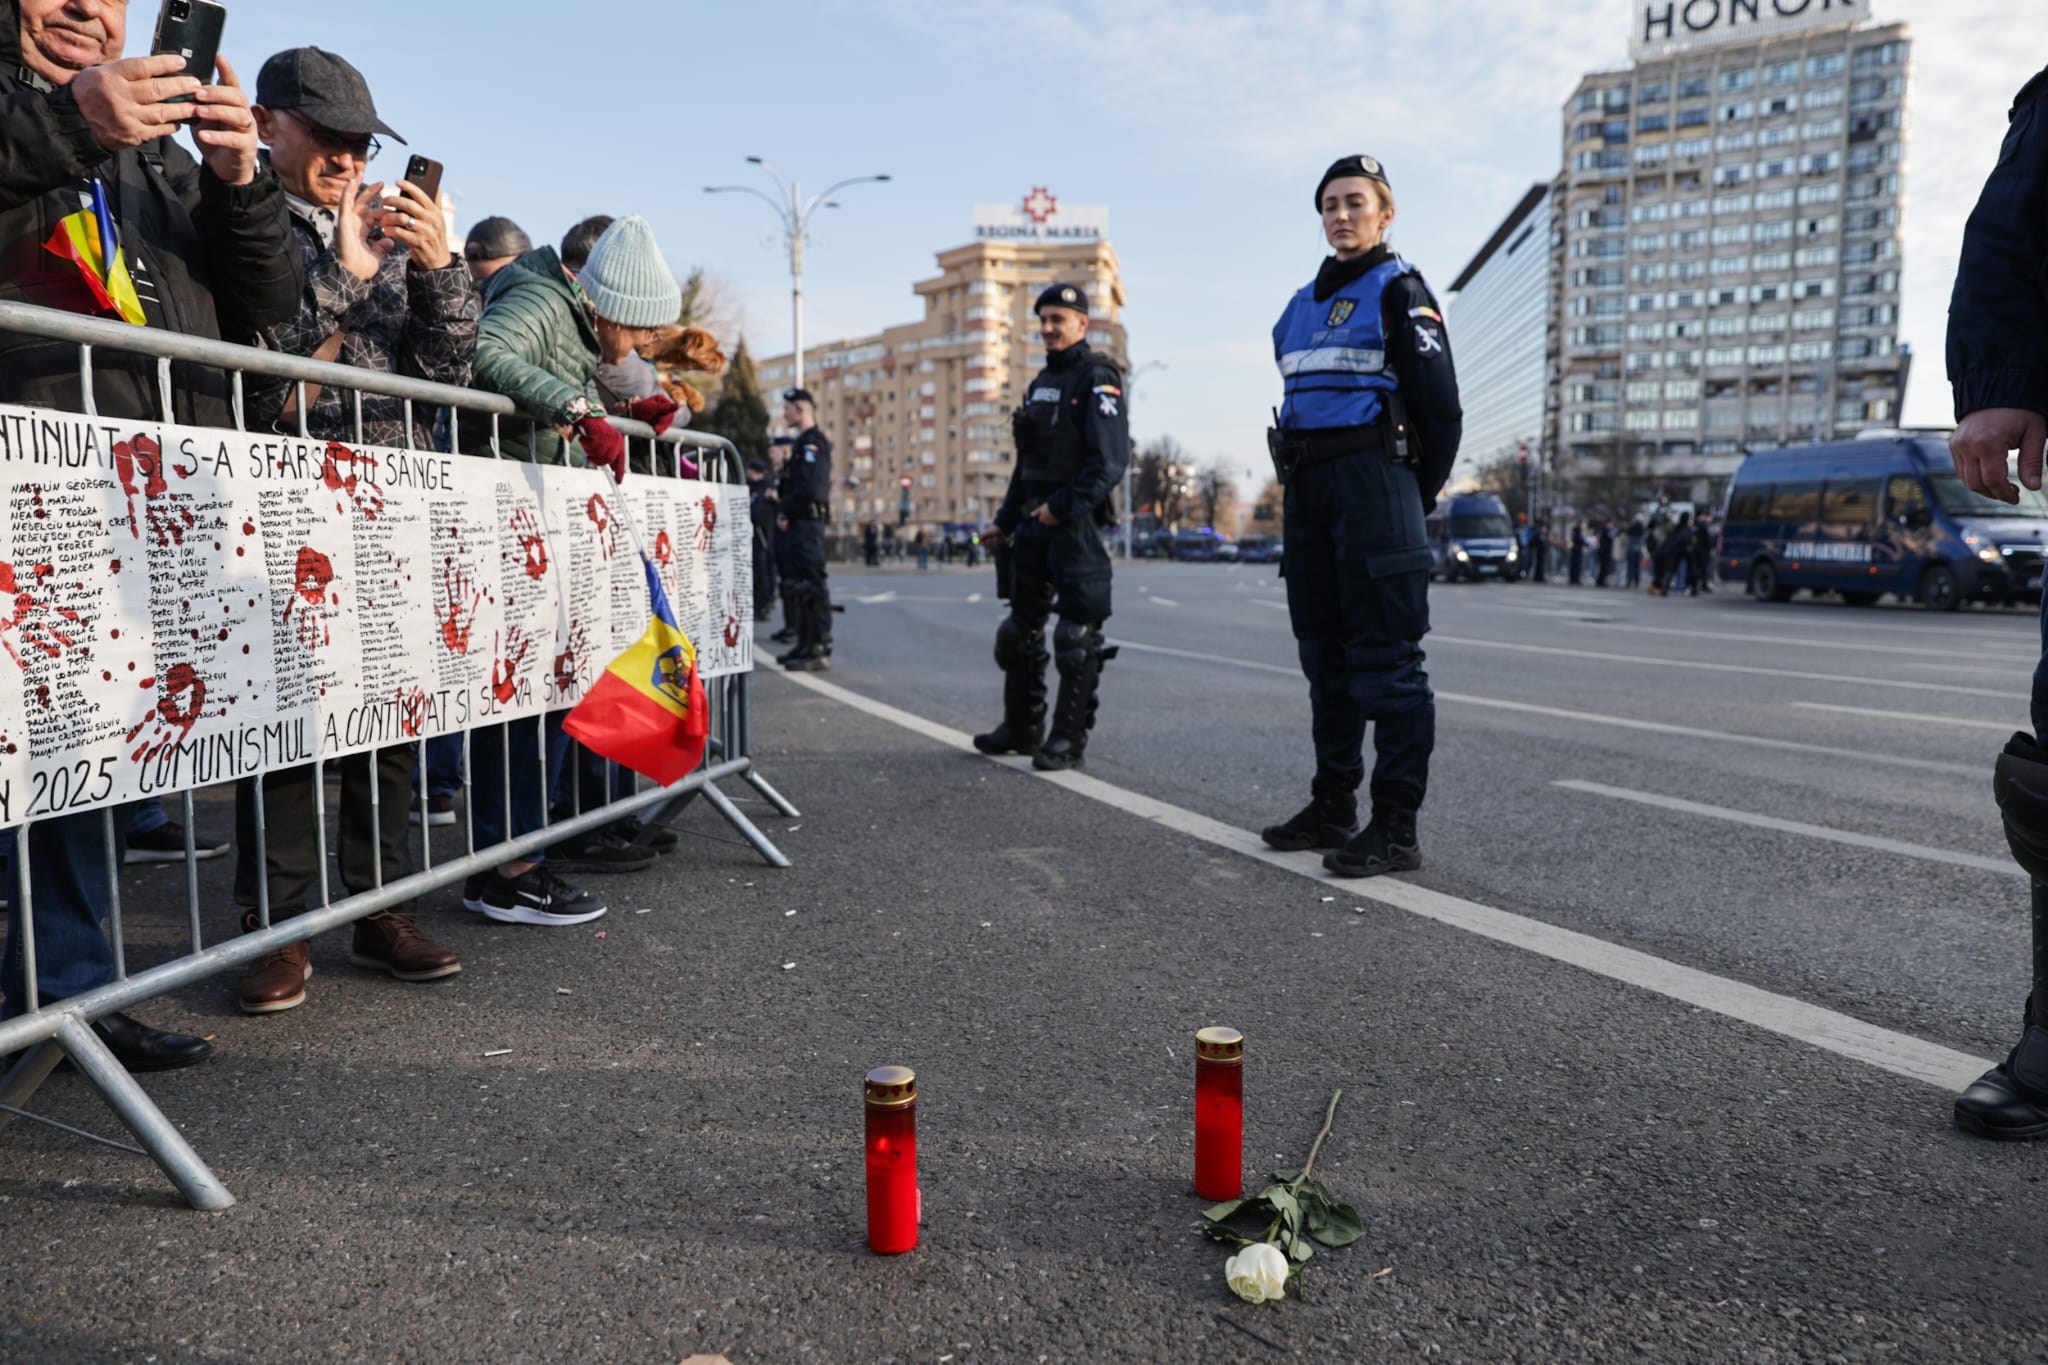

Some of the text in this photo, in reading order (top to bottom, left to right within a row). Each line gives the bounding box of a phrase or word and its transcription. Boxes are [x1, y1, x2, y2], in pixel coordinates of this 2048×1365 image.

[1645, 0, 1853, 41] HON
[180, 437, 234, 478] S-A
[351, 449, 375, 484] CU
[385, 450, 453, 491] SÂNGE
[57, 540, 94, 551] GEORGE
[56, 680, 78, 690] EMIL
[139, 717, 313, 794] COMUNISMUL
